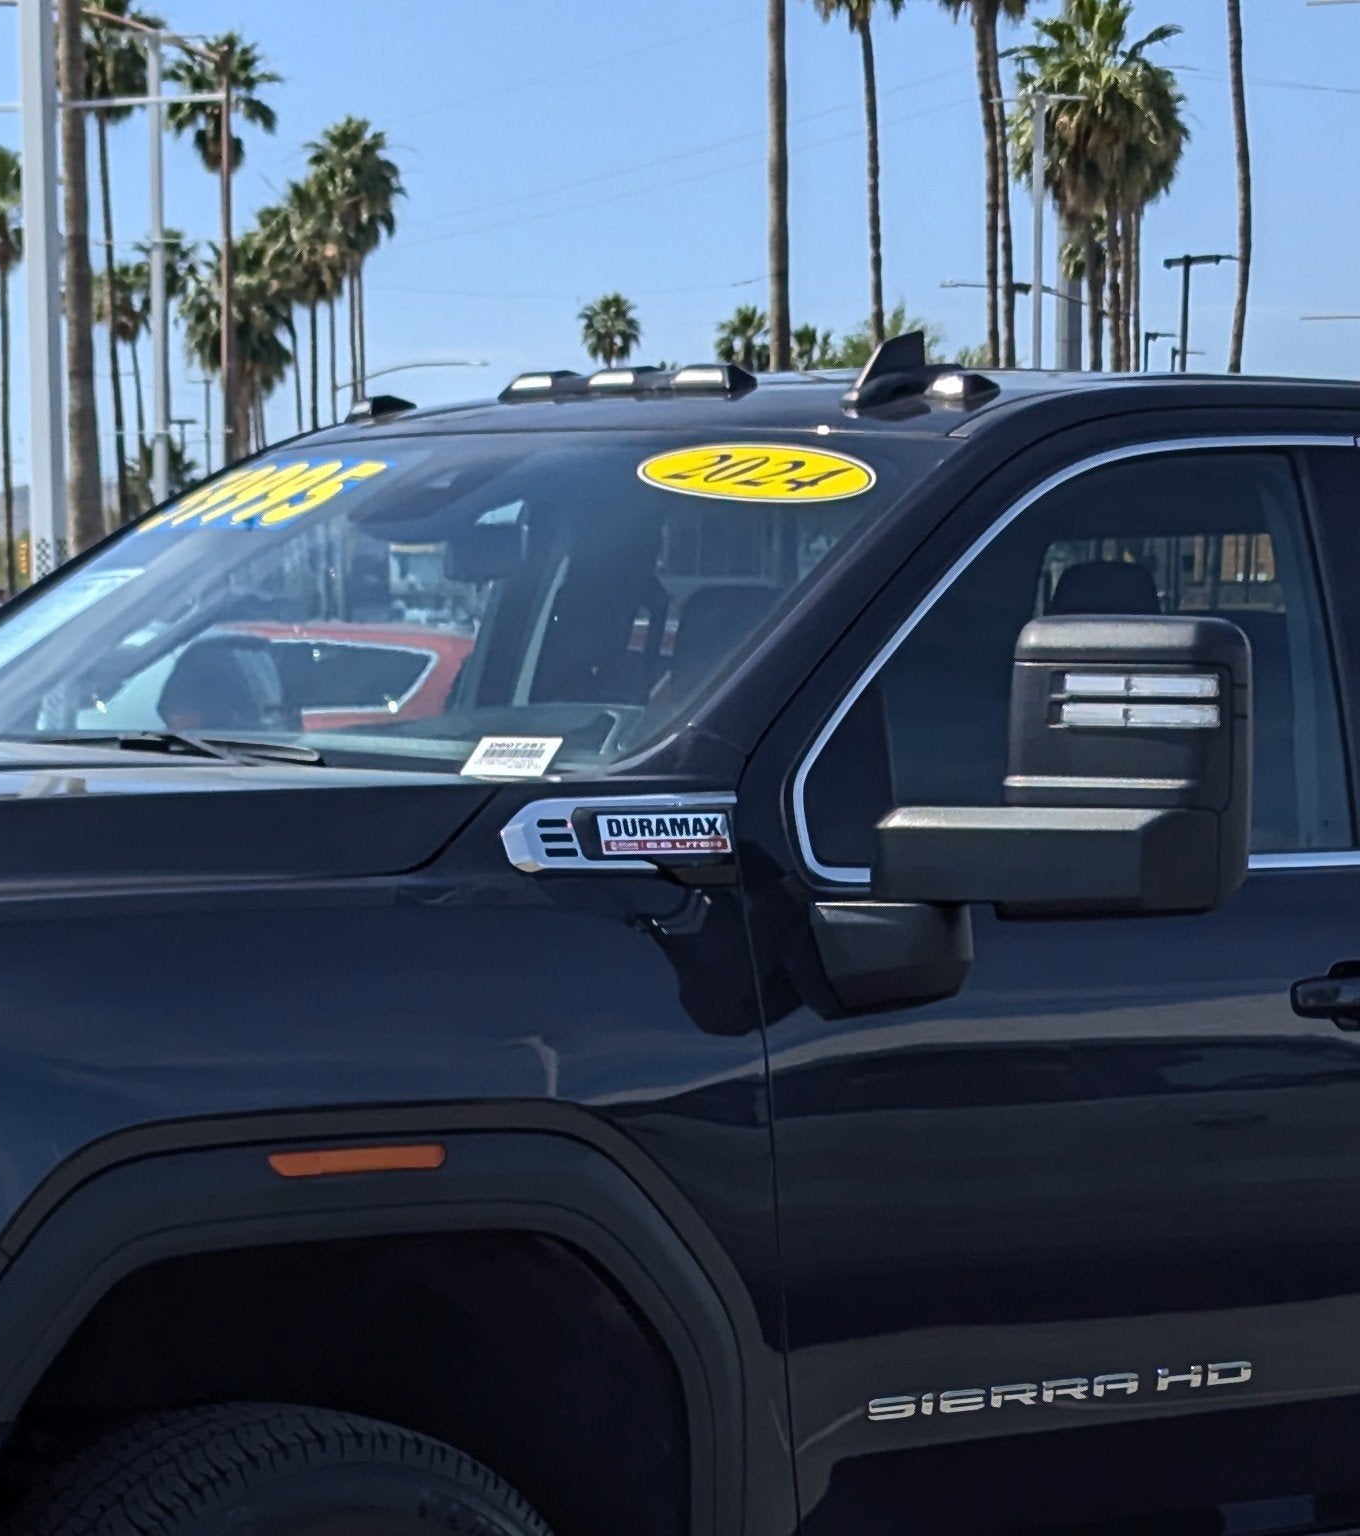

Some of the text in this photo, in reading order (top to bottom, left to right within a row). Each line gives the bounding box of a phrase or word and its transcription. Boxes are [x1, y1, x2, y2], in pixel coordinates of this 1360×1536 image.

[661, 454, 854, 492] 2024
[606, 817, 721, 837] DURAMAX
[867, 1360, 1252, 1421] SIERRA HD
